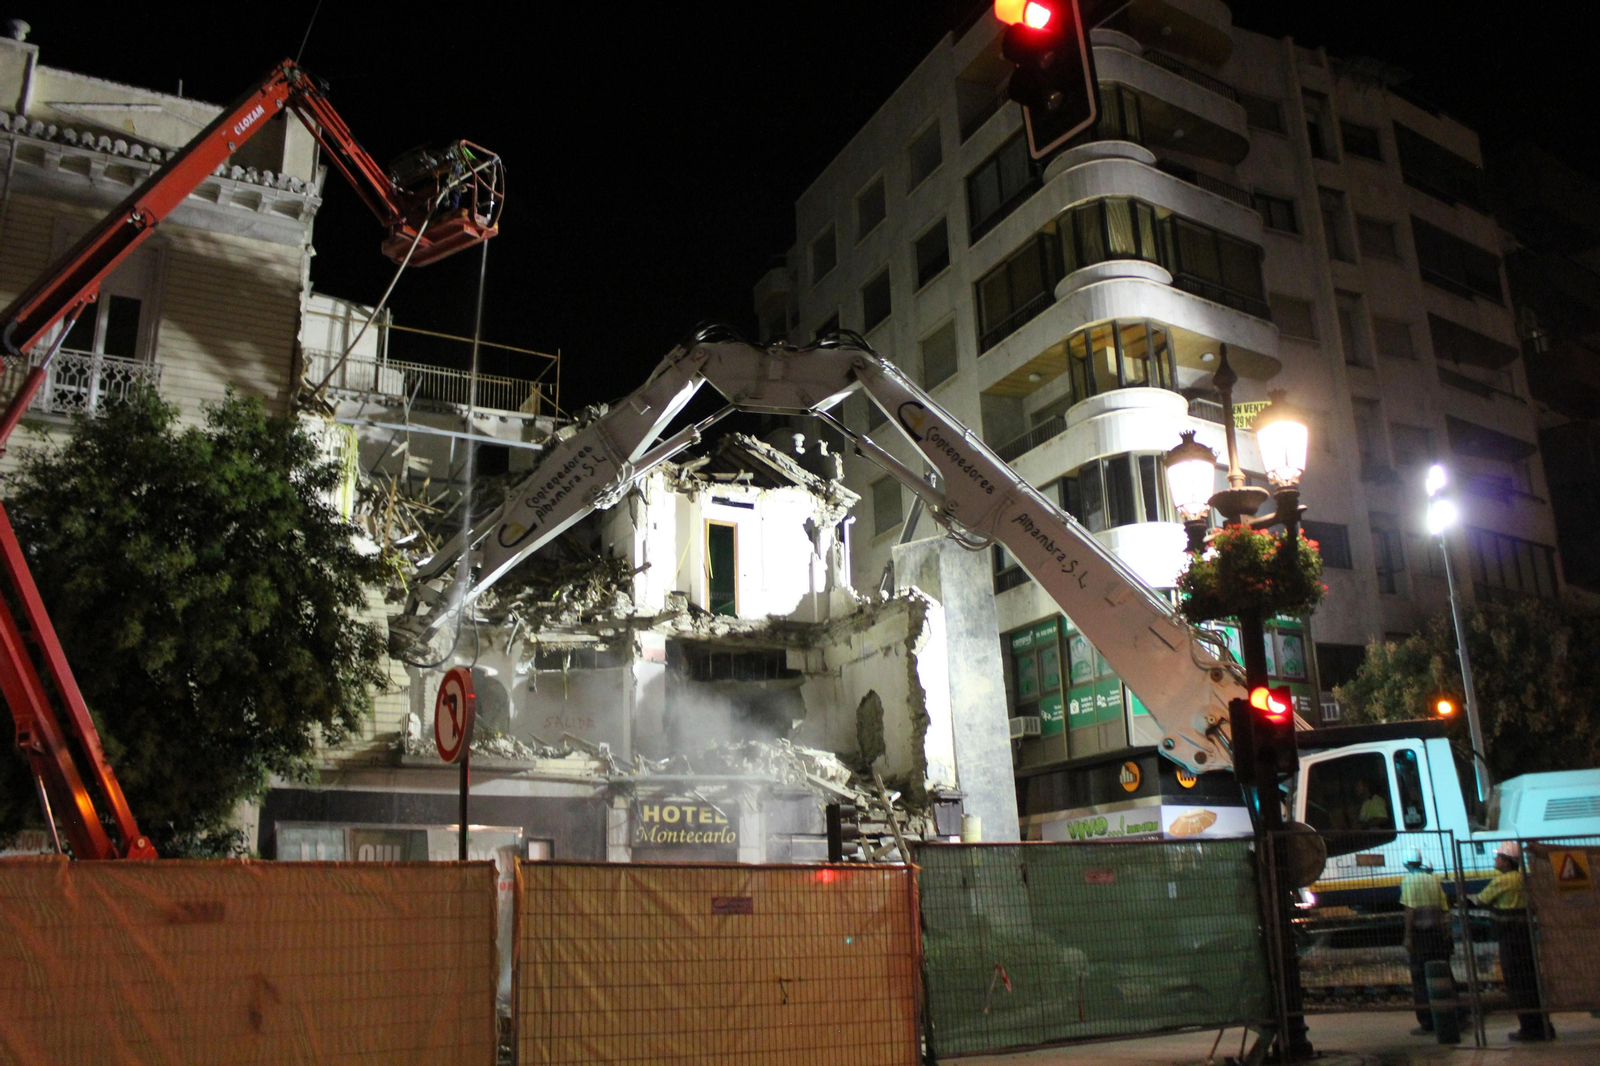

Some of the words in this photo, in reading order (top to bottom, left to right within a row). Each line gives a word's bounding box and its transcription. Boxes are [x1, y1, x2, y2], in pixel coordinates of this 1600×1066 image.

[239, 105, 265, 131] LOXAM
[926, 426, 995, 495] Contenedores
[526, 445, 593, 508] Contenedores
[642, 805, 729, 824] HOTEL
[635, 824, 737, 844] Montecarlo
